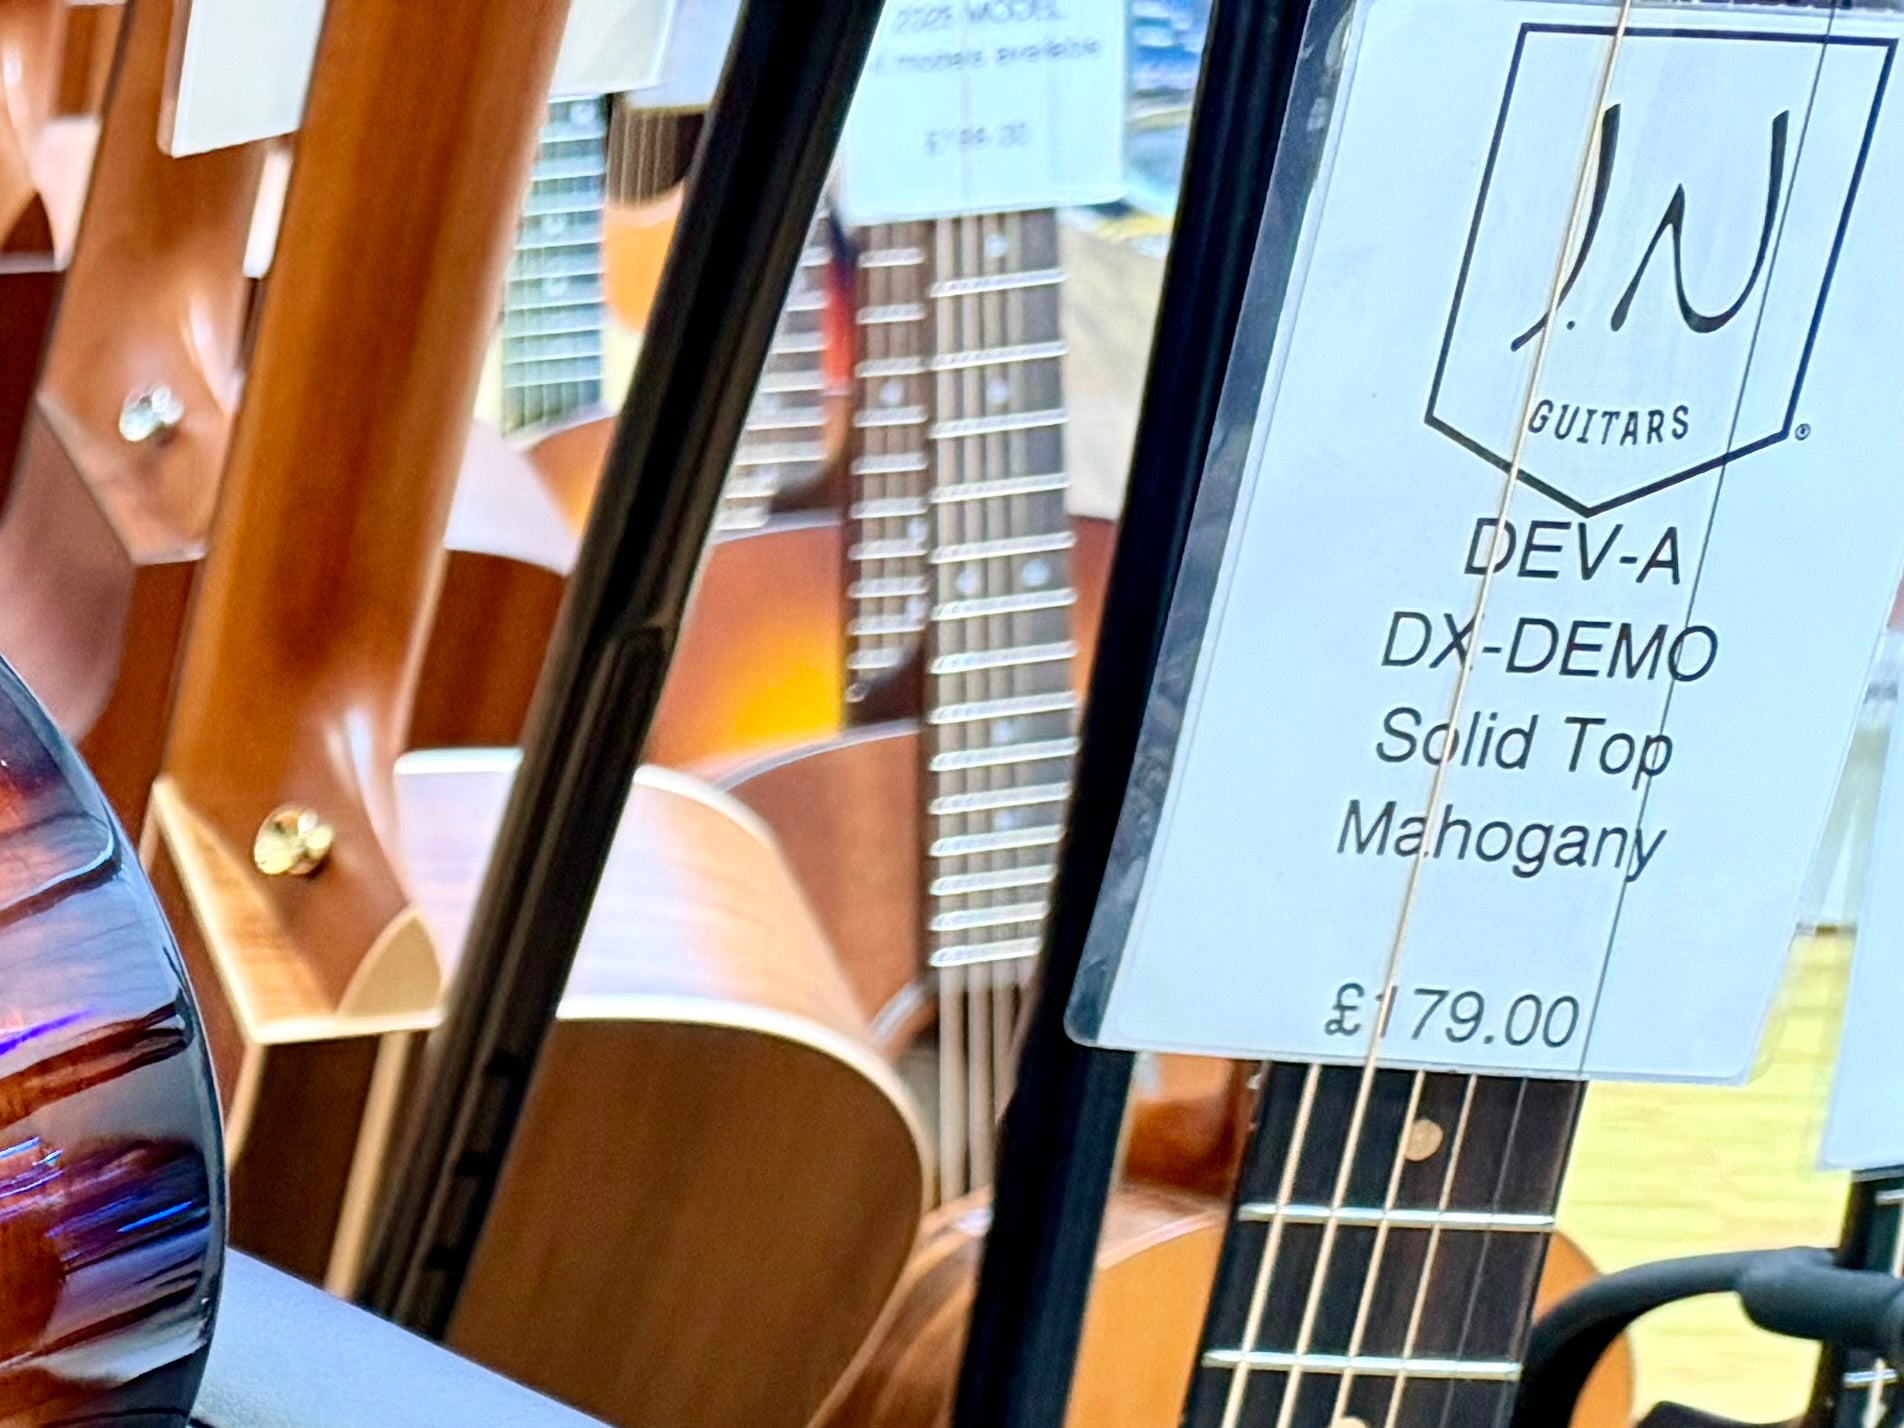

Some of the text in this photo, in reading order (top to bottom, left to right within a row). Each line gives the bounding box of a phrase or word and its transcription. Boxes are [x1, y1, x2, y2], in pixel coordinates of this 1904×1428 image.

[1528, 399, 1691, 447] GUITARS
[1463, 517, 1681, 585] DEV-A
[1381, 611, 1719, 683] DX-DEMO
[1376, 706, 1674, 790] Solid Top
[1336, 798, 1668, 883] Mahogany
[1323, 981, 1580, 1049] £179.00
